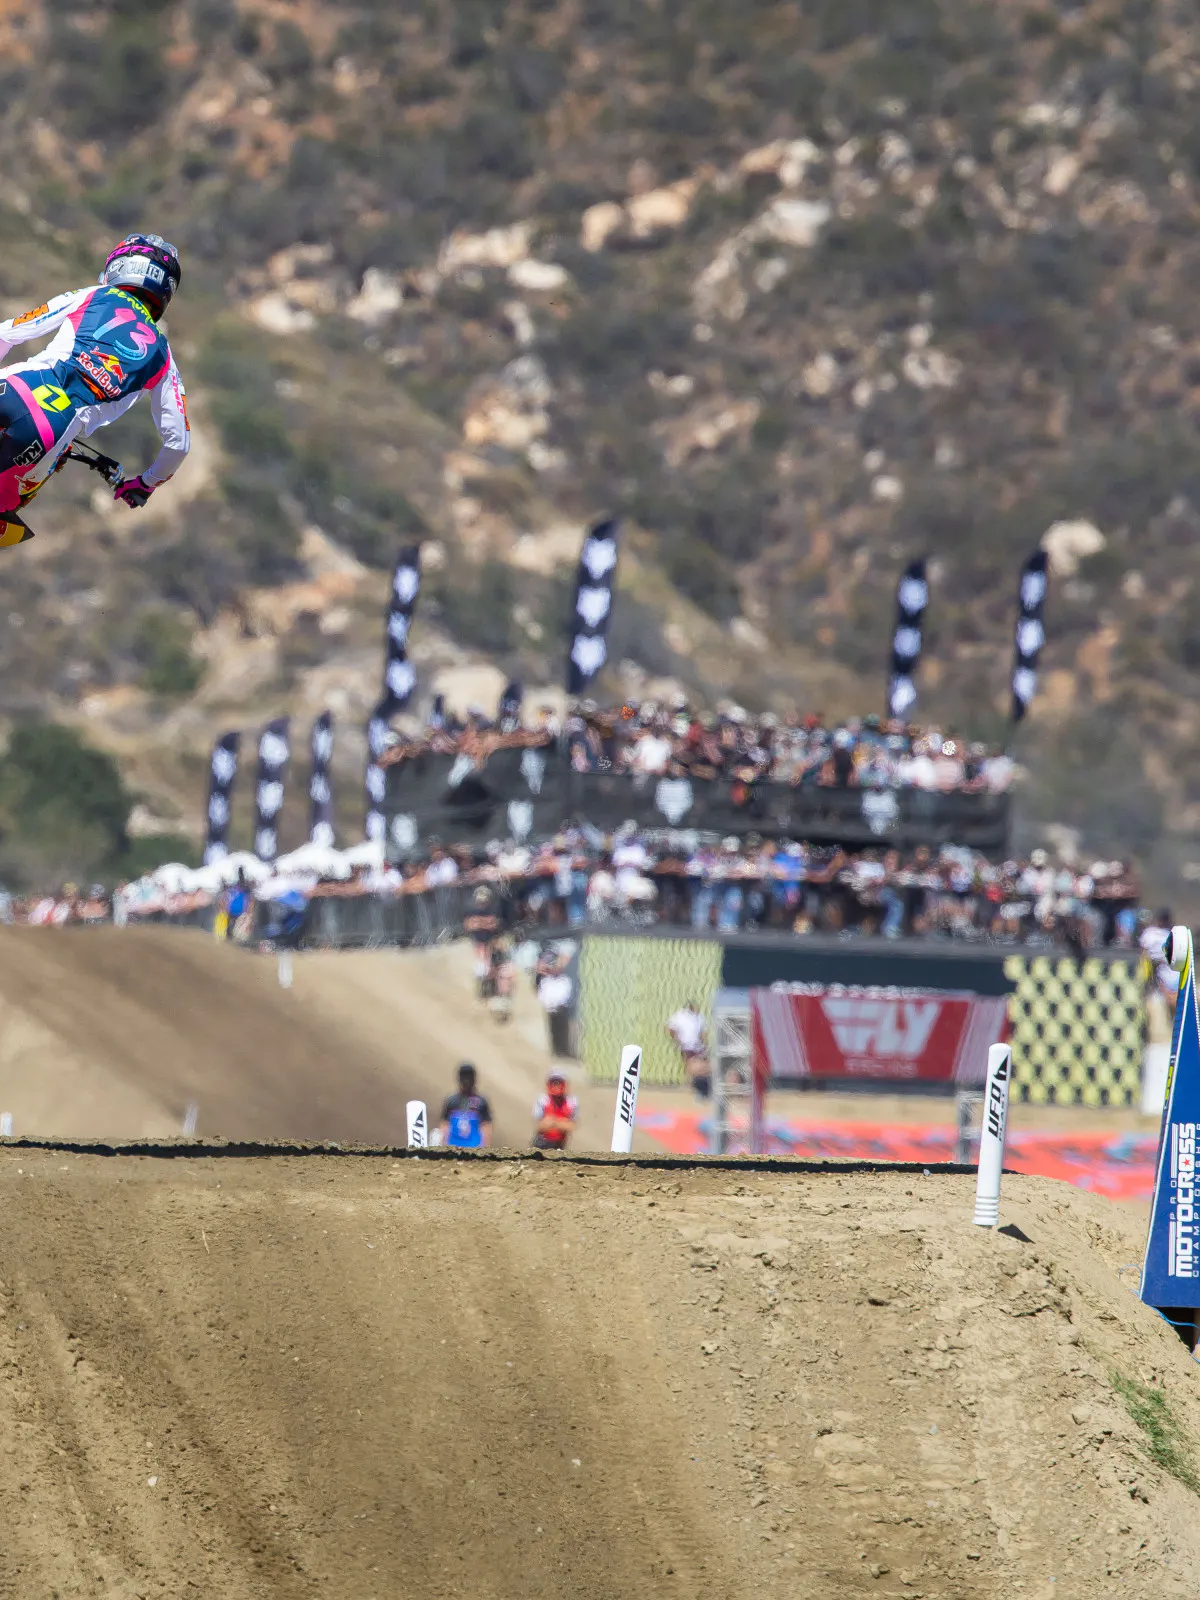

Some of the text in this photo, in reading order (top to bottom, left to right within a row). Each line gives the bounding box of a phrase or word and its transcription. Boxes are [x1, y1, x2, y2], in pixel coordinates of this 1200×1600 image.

[92, 308, 157, 361] 13
[76, 351, 122, 399] Red Bull
[13, 440, 43, 467] KTM
[819, 999, 941, 1058] FLY
[620, 1076, 632, 1123] UFO
[988, 1081, 1001, 1138] UFO
[1169, 1180, 1178, 1221] PRO
[1176, 1122, 1196, 1278] MOTOCROSS
